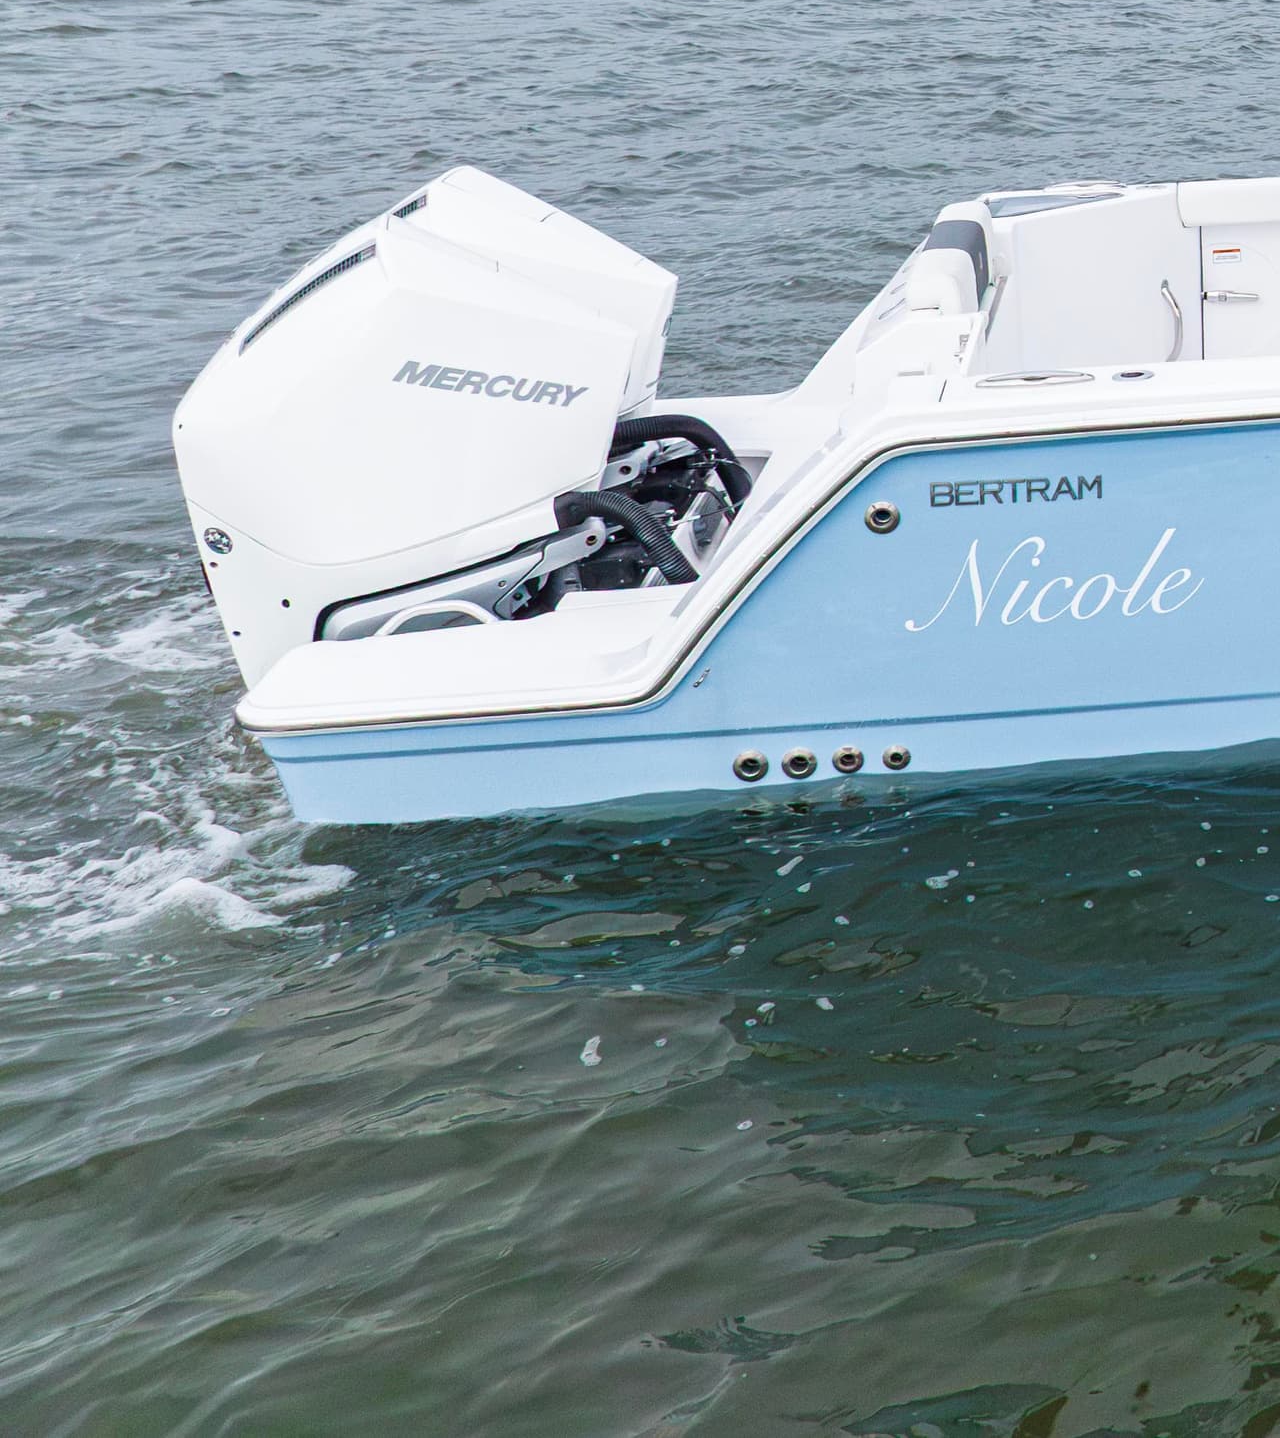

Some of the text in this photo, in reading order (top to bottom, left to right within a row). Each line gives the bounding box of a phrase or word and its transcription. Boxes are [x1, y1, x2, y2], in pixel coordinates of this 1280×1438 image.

[392, 360, 589, 407] MERCURY
[929, 474, 1103, 508] BERTRAM
[904, 527, 1205, 632] Nicole
